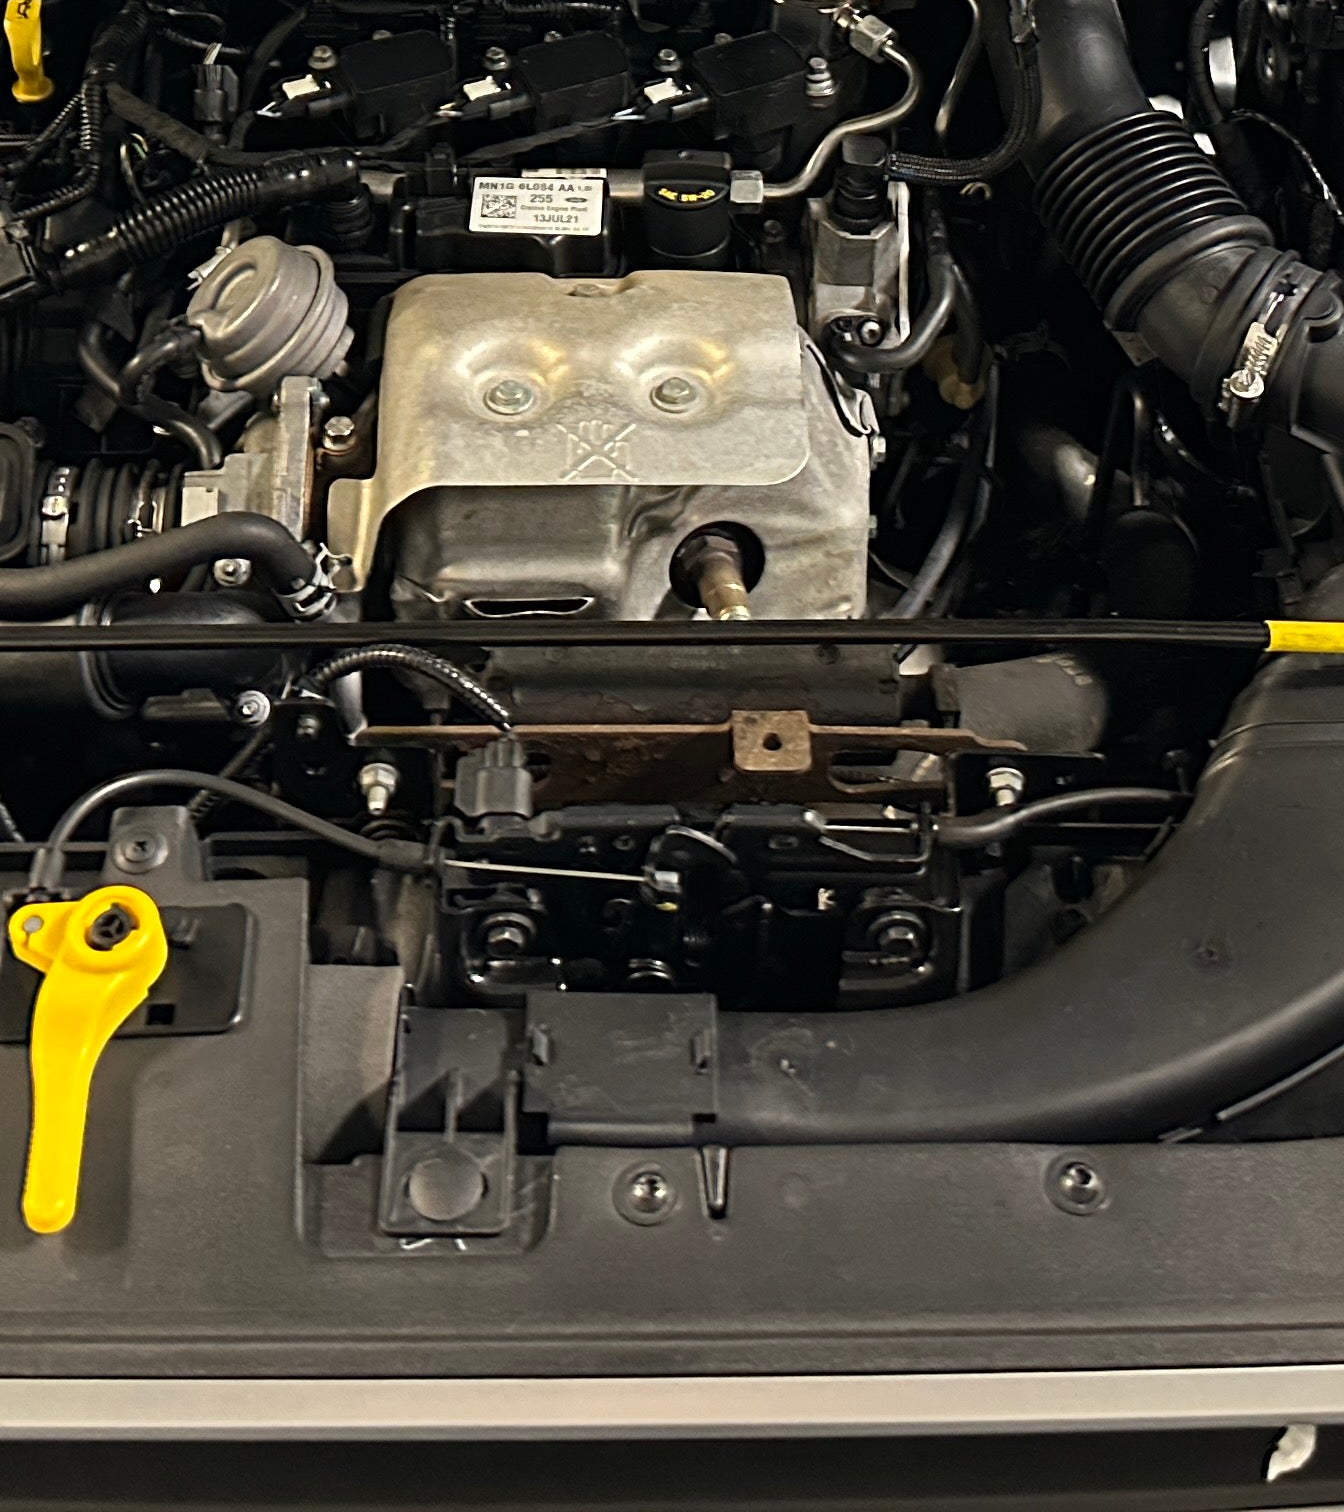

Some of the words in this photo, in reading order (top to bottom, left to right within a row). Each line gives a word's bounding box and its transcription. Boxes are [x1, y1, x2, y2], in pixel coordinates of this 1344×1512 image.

[479, 182, 514, 190] MN1G
[530, 194, 553, 203] 255
[533, 214, 579, 223] 13JUL21
